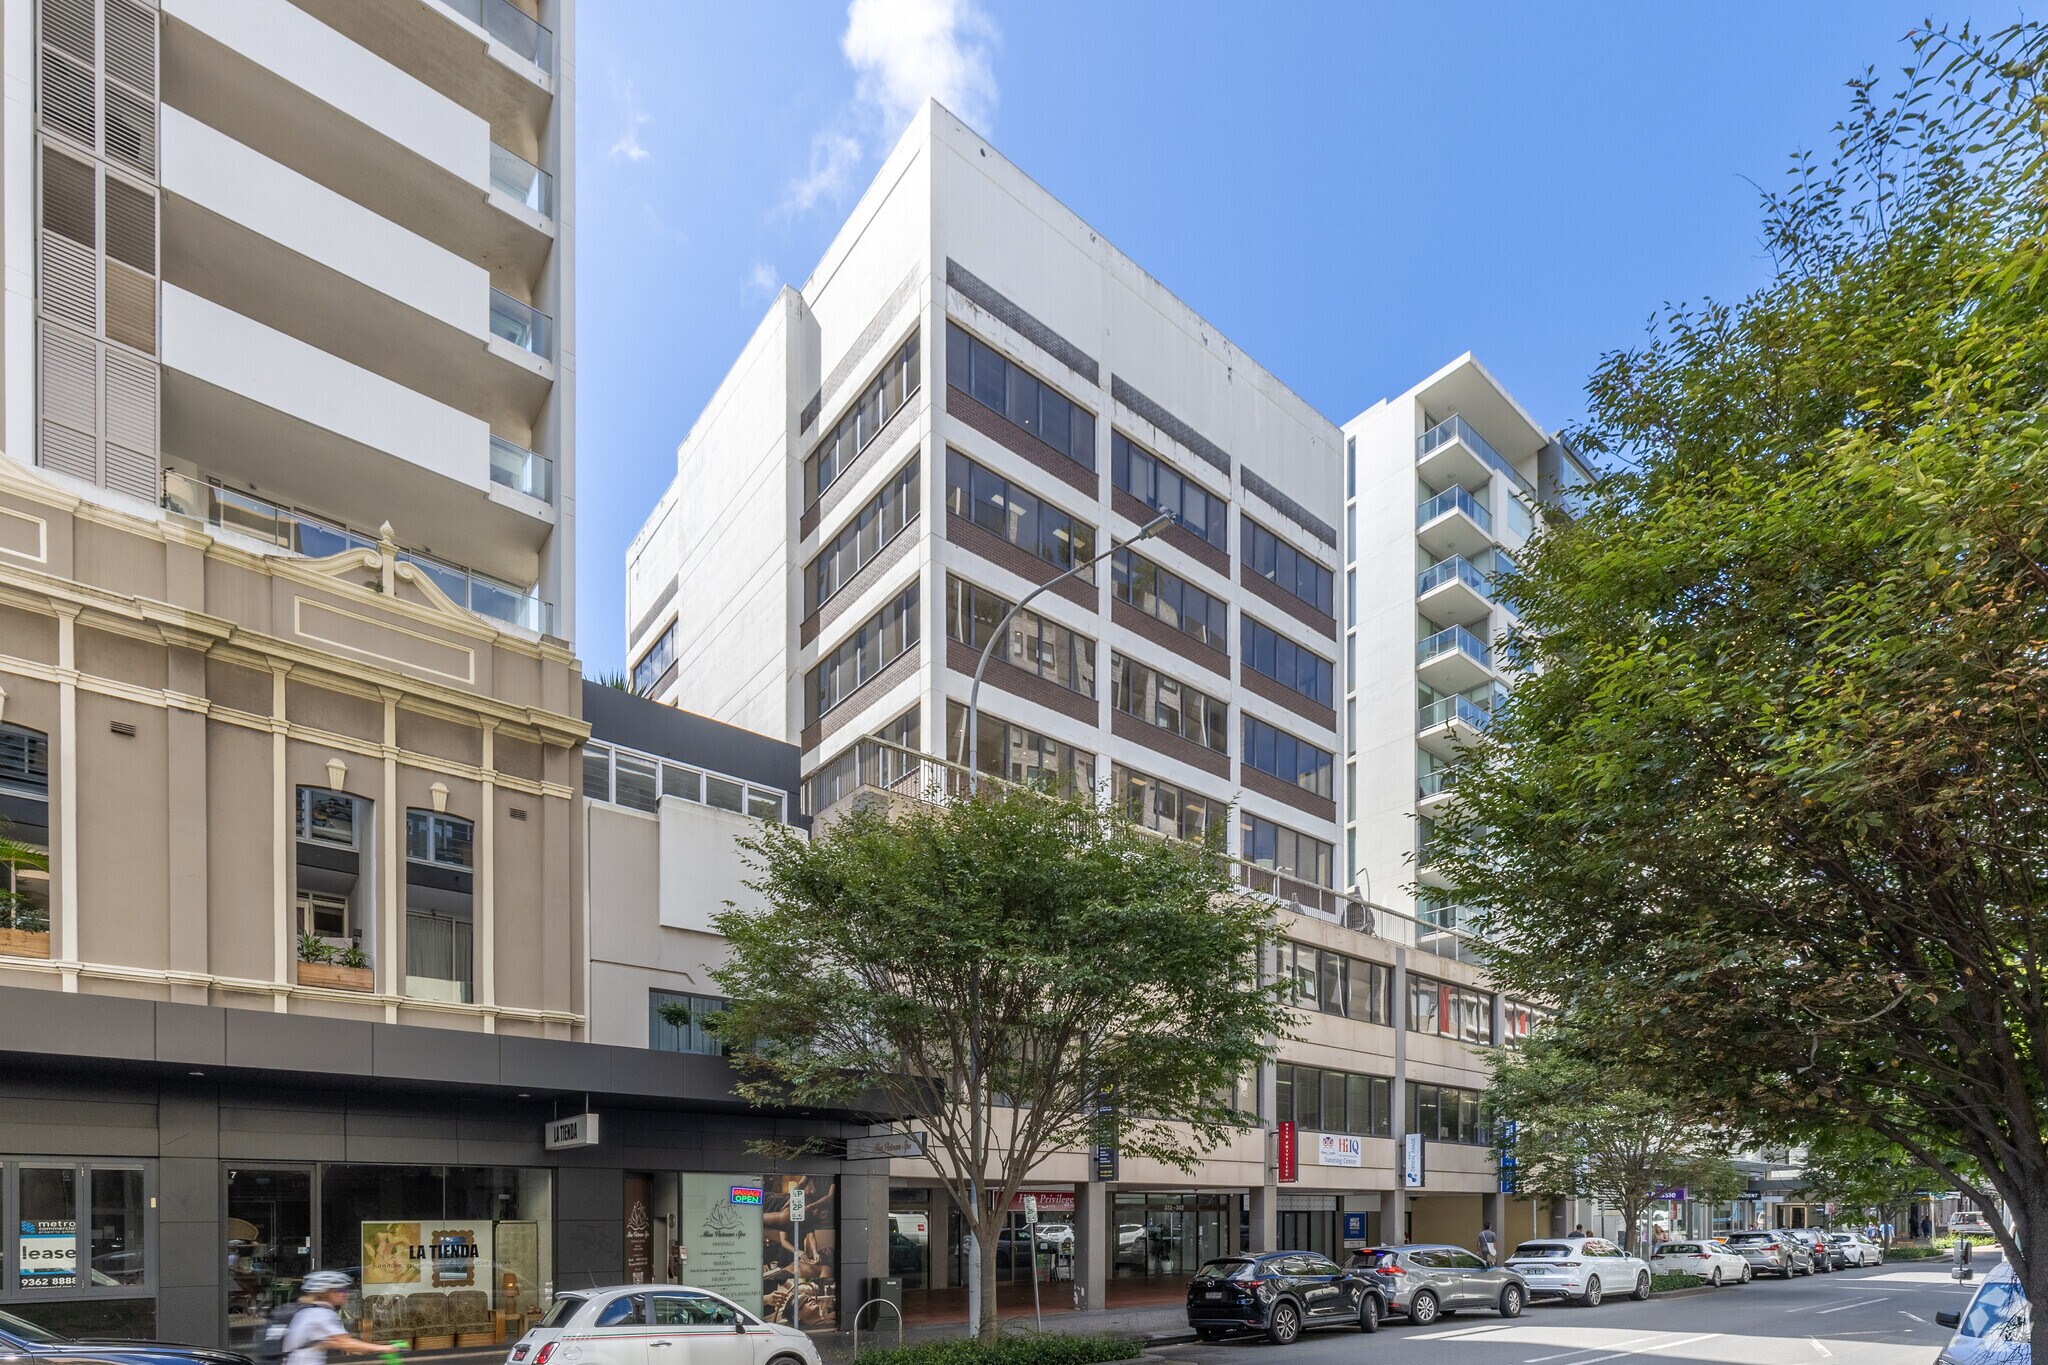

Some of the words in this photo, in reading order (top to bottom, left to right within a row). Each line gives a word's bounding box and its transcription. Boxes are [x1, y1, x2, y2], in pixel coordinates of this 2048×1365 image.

[553, 1125, 560, 1143] LA
[560, 1122, 578, 1142] TIENDA
[1324, 1156, 1342, 1165] Tutoring
[230, 1171, 237, 1179] 7
[735, 1195, 759, 1203] OPEN
[1039, 1193, 1075, 1206] Privilege
[792, 1203, 803, 1211] 2P
[22, 1245, 76, 1260] lease
[409, 1244, 426, 1260] LA
[429, 1243, 480, 1259] TIENDA
[21, 1278, 49, 1286] 9362
